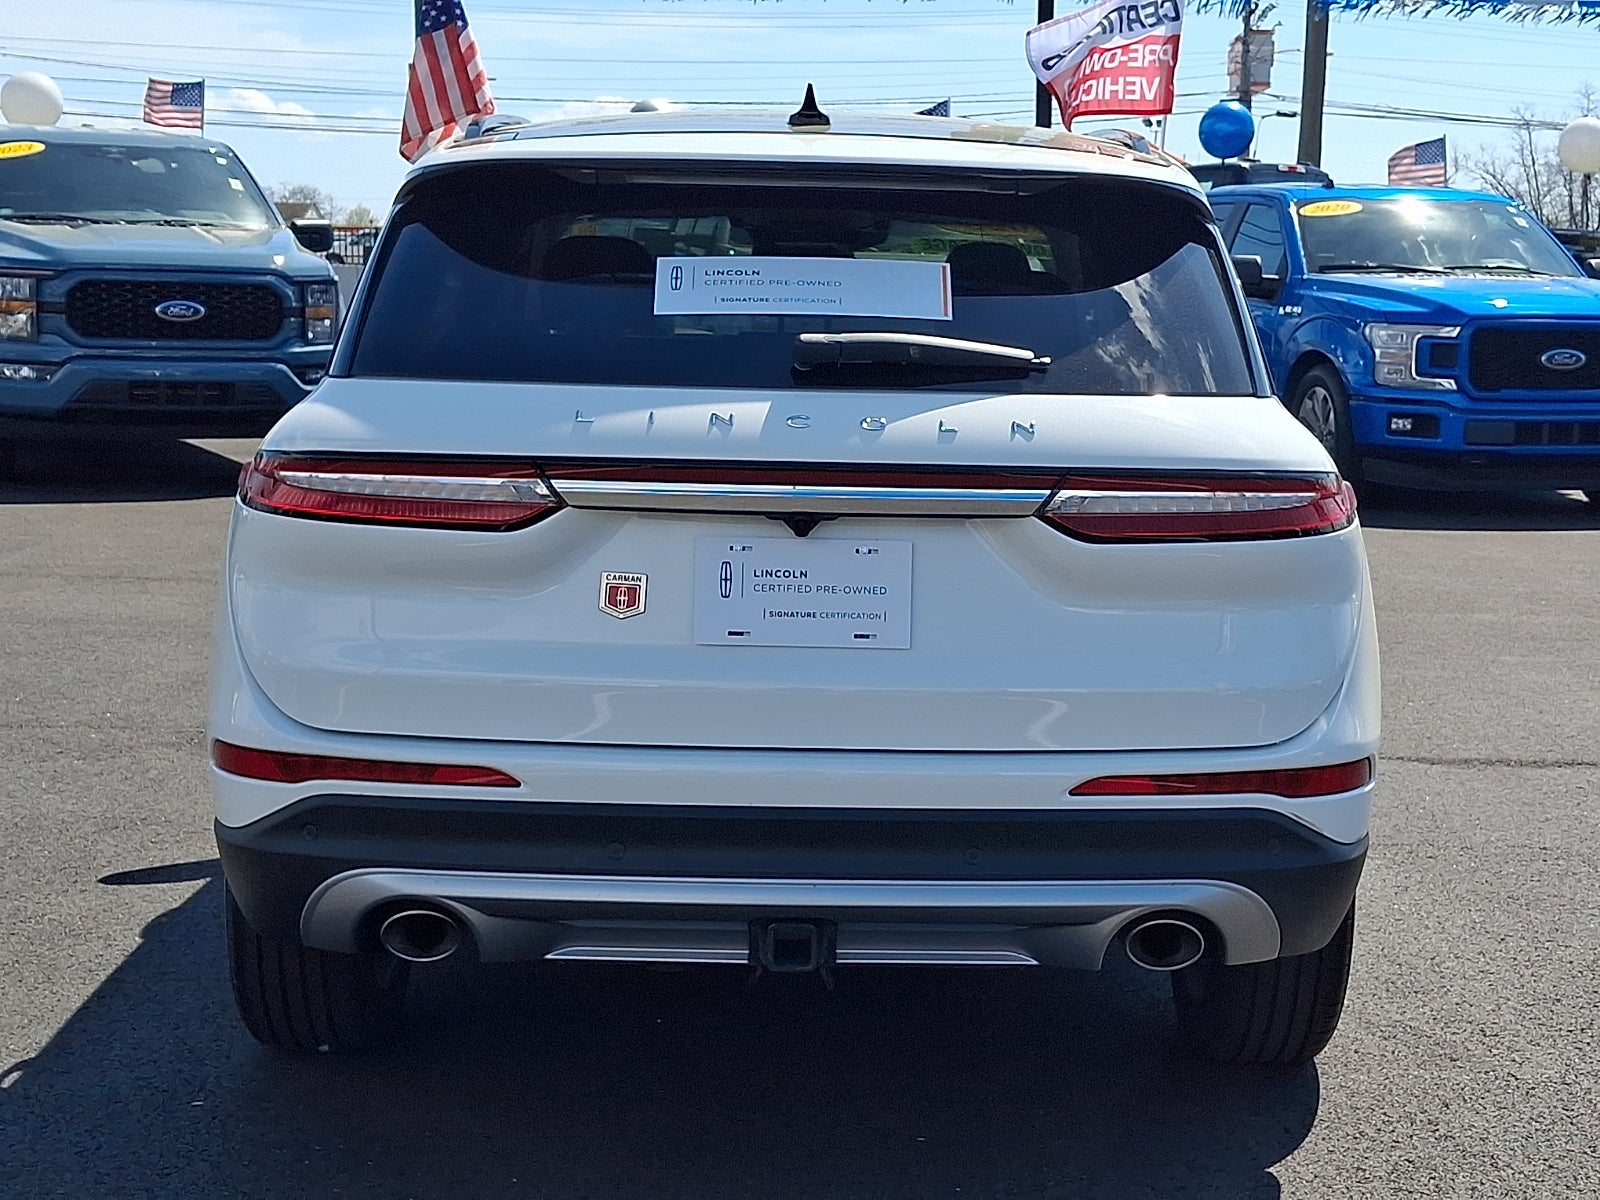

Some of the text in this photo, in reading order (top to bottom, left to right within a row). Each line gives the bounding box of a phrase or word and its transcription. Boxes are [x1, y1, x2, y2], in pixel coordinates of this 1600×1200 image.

[1309, 203, 1352, 214] 2020
[704, 269, 761, 277] LINCOLN
[574, 408, 1036, 438] LINCOLN
[605, 573, 642, 583] CARMAN
[753, 569, 808, 580] LINCOLN
[753, 583, 888, 596] CERTIFIED PRE-OWNED
[769, 610, 882, 621] SIGNATURE CERTIFICATION
